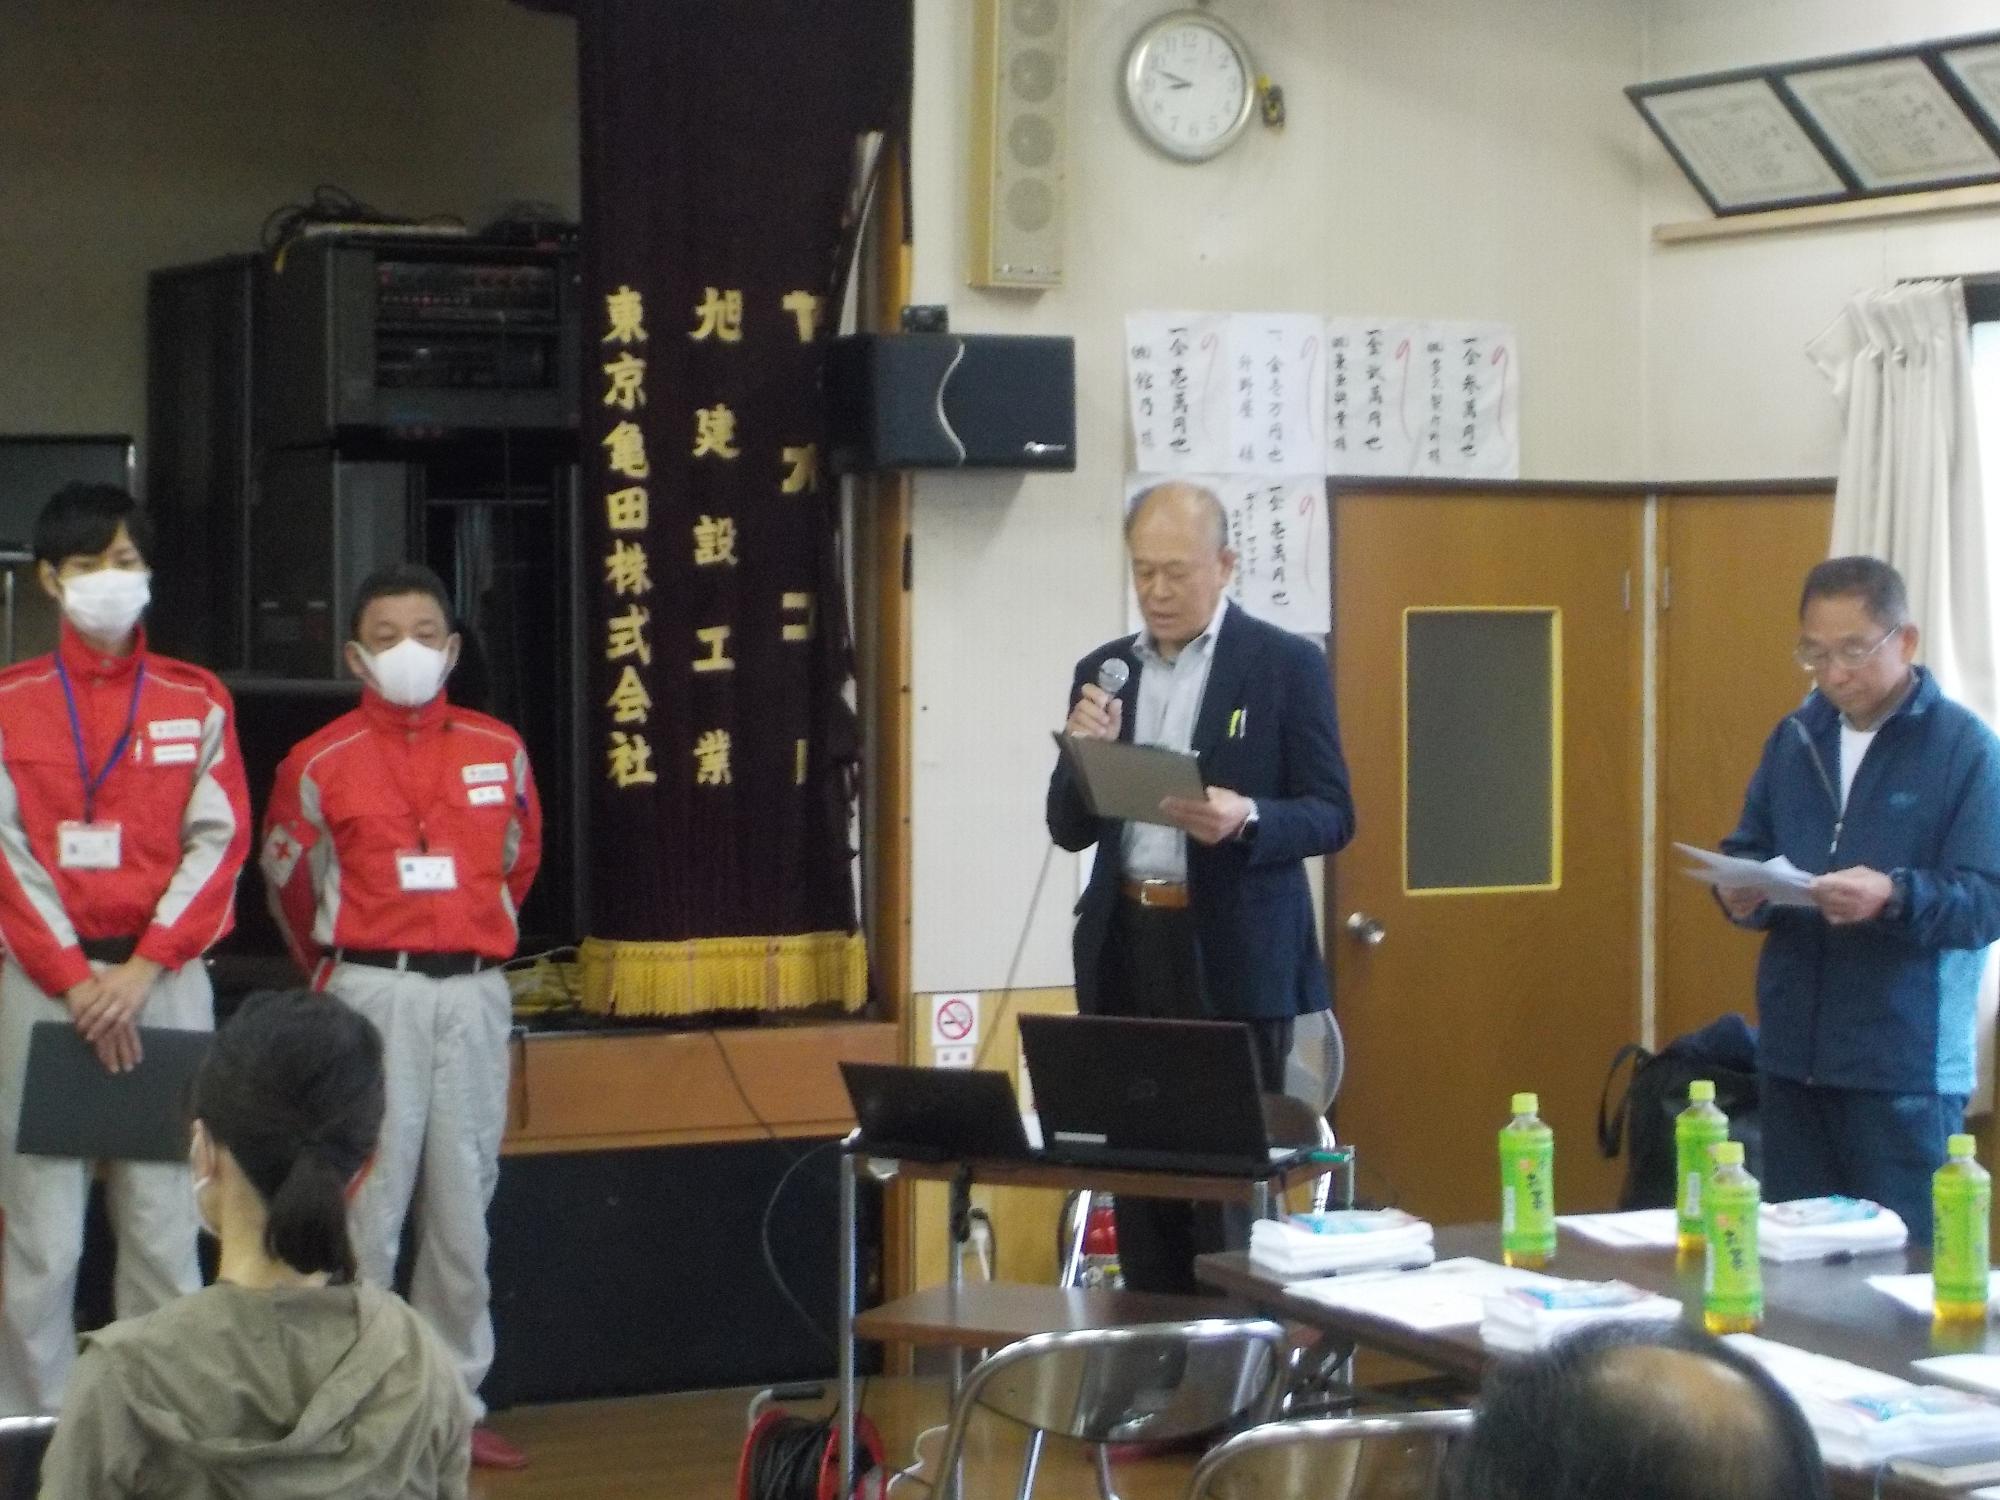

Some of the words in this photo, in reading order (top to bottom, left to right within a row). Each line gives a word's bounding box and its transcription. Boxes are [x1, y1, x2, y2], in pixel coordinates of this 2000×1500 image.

[601, 284, 658, 789] 東京亀田株式会社
[688, 287, 743, 786] 旭建設工業
